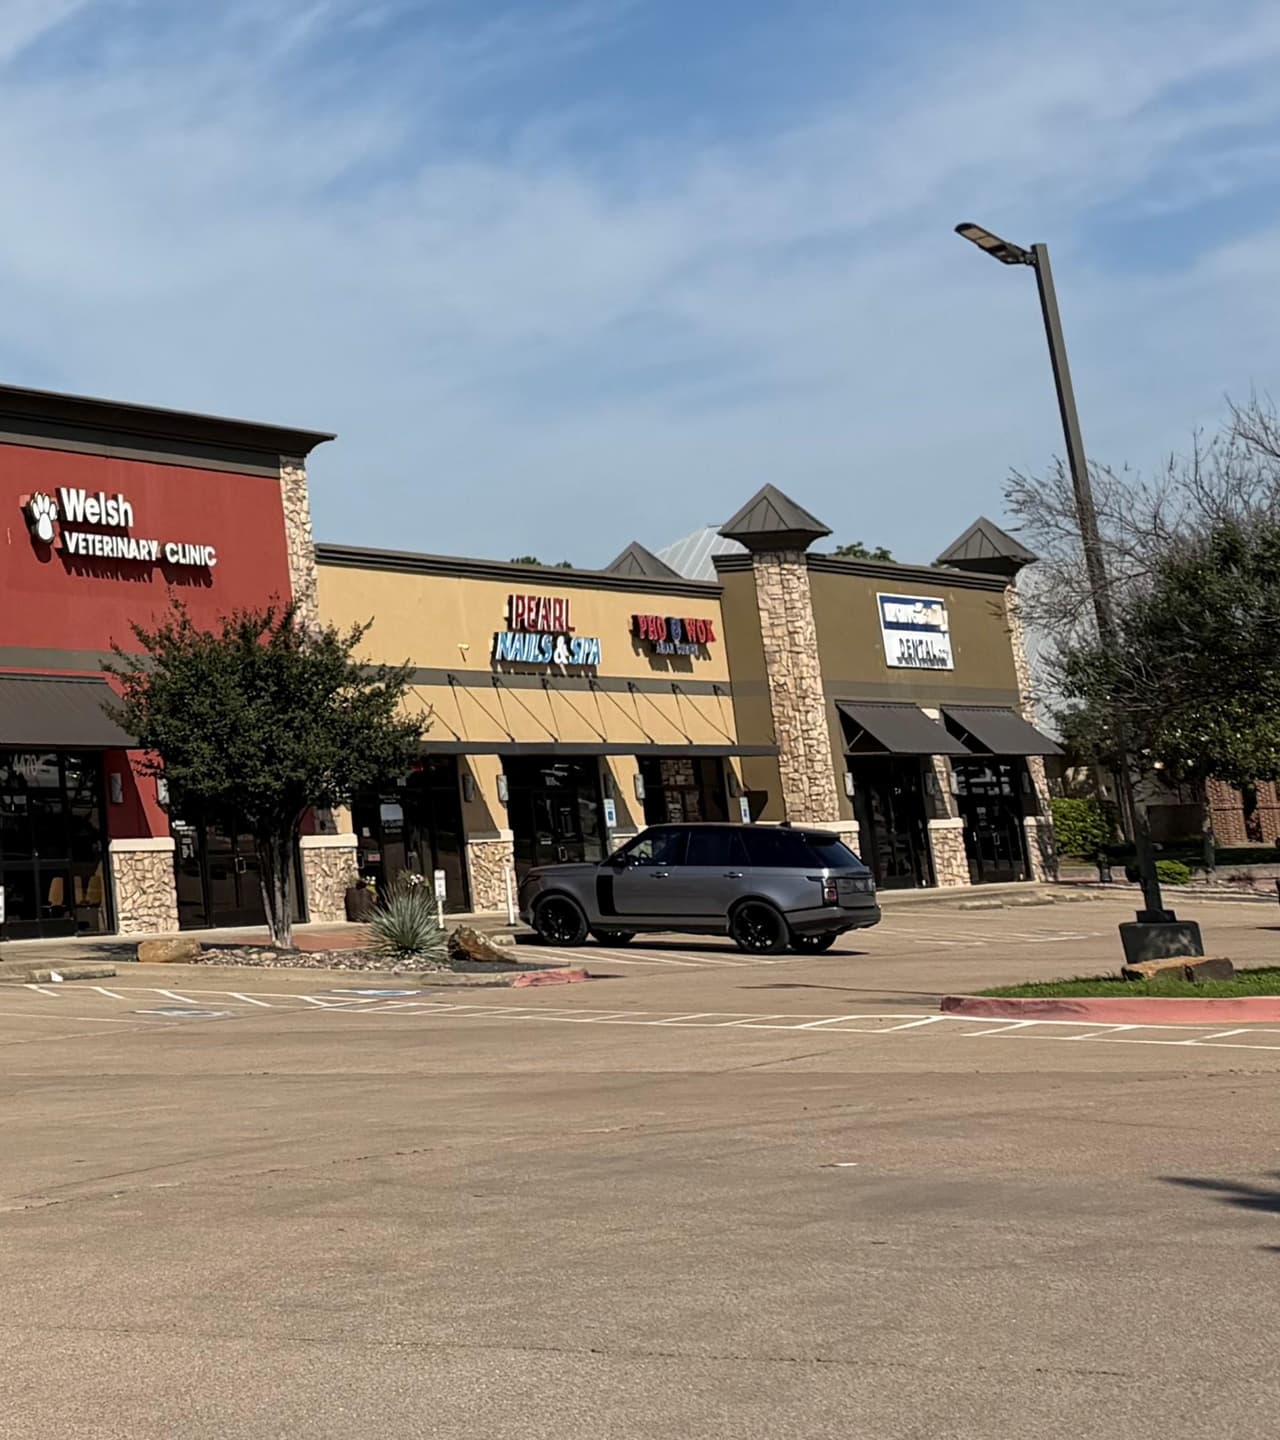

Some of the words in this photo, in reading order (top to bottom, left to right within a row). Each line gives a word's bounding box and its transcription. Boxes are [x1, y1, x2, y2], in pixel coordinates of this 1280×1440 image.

[59, 487, 134, 527] Welsh
[64, 530, 159, 561] VETERINARY
[165, 542, 217, 566] CLINIC
[511, 594, 576, 632] PEARL
[637, 614, 667, 640] PHO
[683, 618, 717, 643] WOK
[496, 632, 553, 663] NAILS
[553, 635, 569, 664] &
[569, 637, 602, 665] SPA
